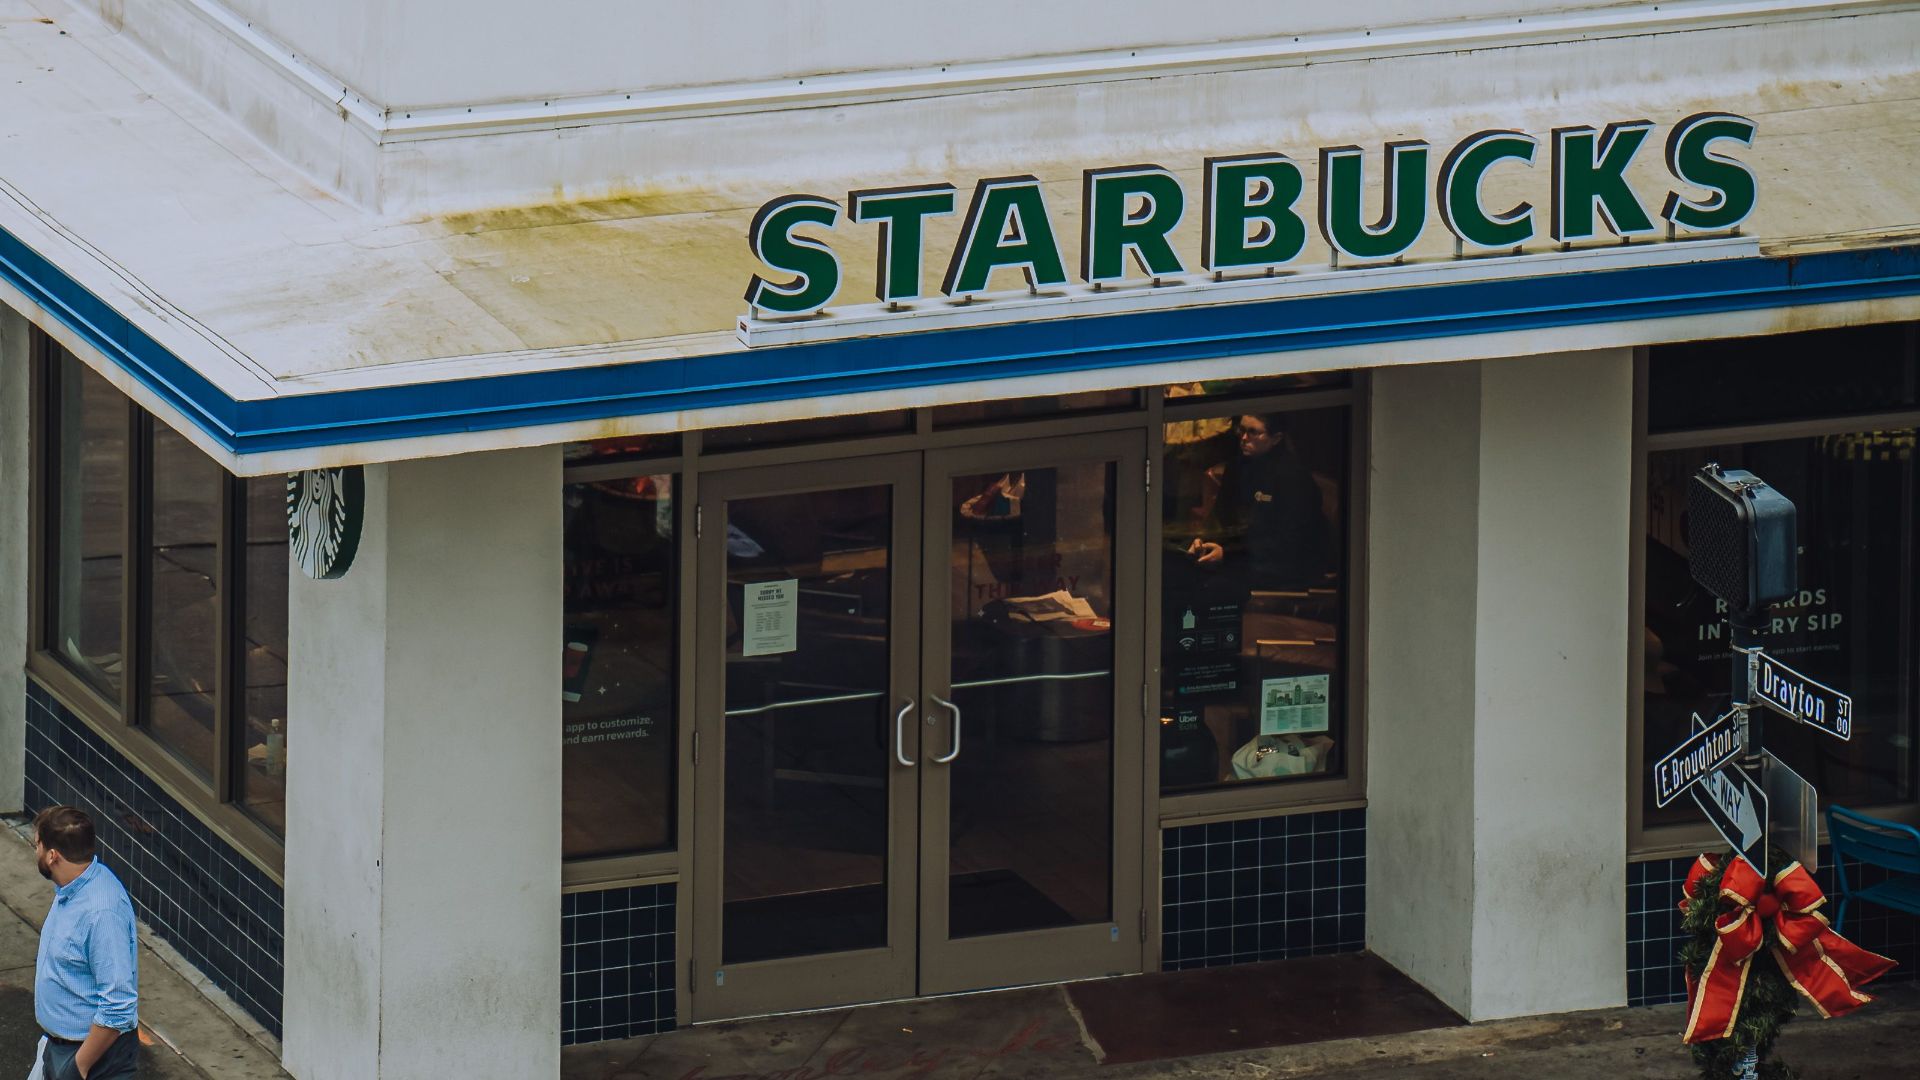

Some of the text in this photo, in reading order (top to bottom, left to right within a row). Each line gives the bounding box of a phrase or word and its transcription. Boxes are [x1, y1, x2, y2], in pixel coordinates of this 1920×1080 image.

[746, 111, 1758, 315] STARBUCKS
[1715, 588, 1827, 614] RRDS
[1698, 623, 1721, 641] IN
[1807, 613, 1843, 632] SIP
[1763, 661, 1849, 723] Drayton ST
[566, 723, 585, 734] app
[587, 721, 598, 730] to
[1179, 715, 1197, 723] Uber
[581, 733, 605, 743] earn
[1720, 775, 1742, 823] WAY
